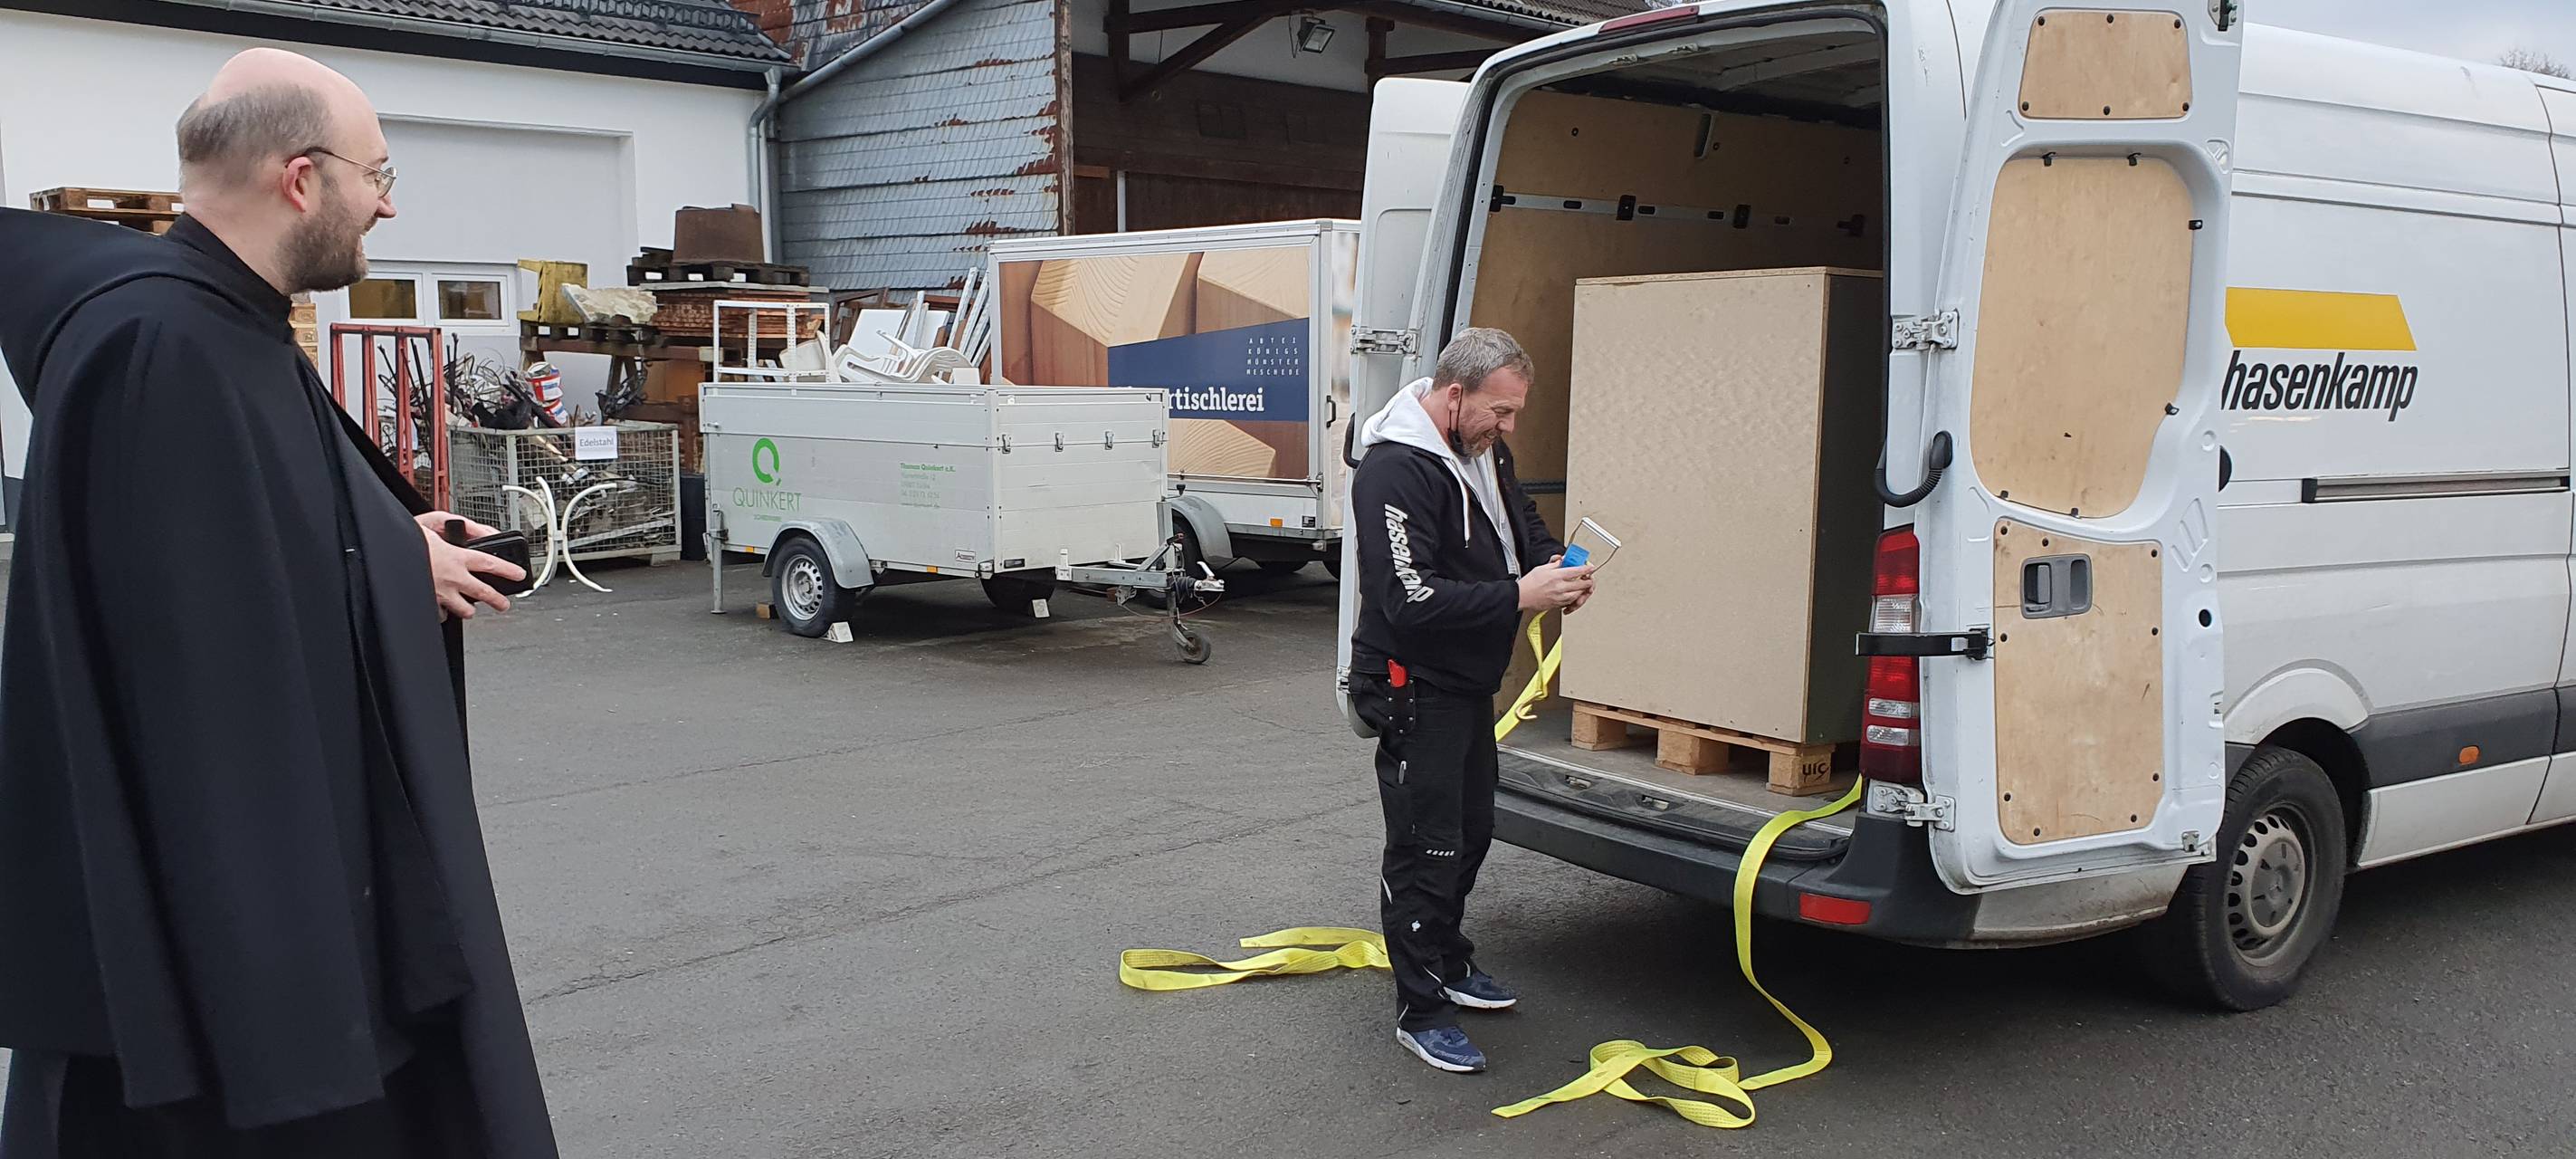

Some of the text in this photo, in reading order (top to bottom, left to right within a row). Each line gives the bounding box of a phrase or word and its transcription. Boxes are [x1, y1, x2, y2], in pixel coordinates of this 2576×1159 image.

[1248, 347, 1298, 355] KÖNIGS
[1246, 358, 1298, 366] MÜNSTER
[2220, 350, 2419, 422] hasenkamp
[1169, 386, 1264, 411] rtischlerei
[579, 437, 615, 446] Edelstahl
[732, 487, 802, 512] QUINKERT
